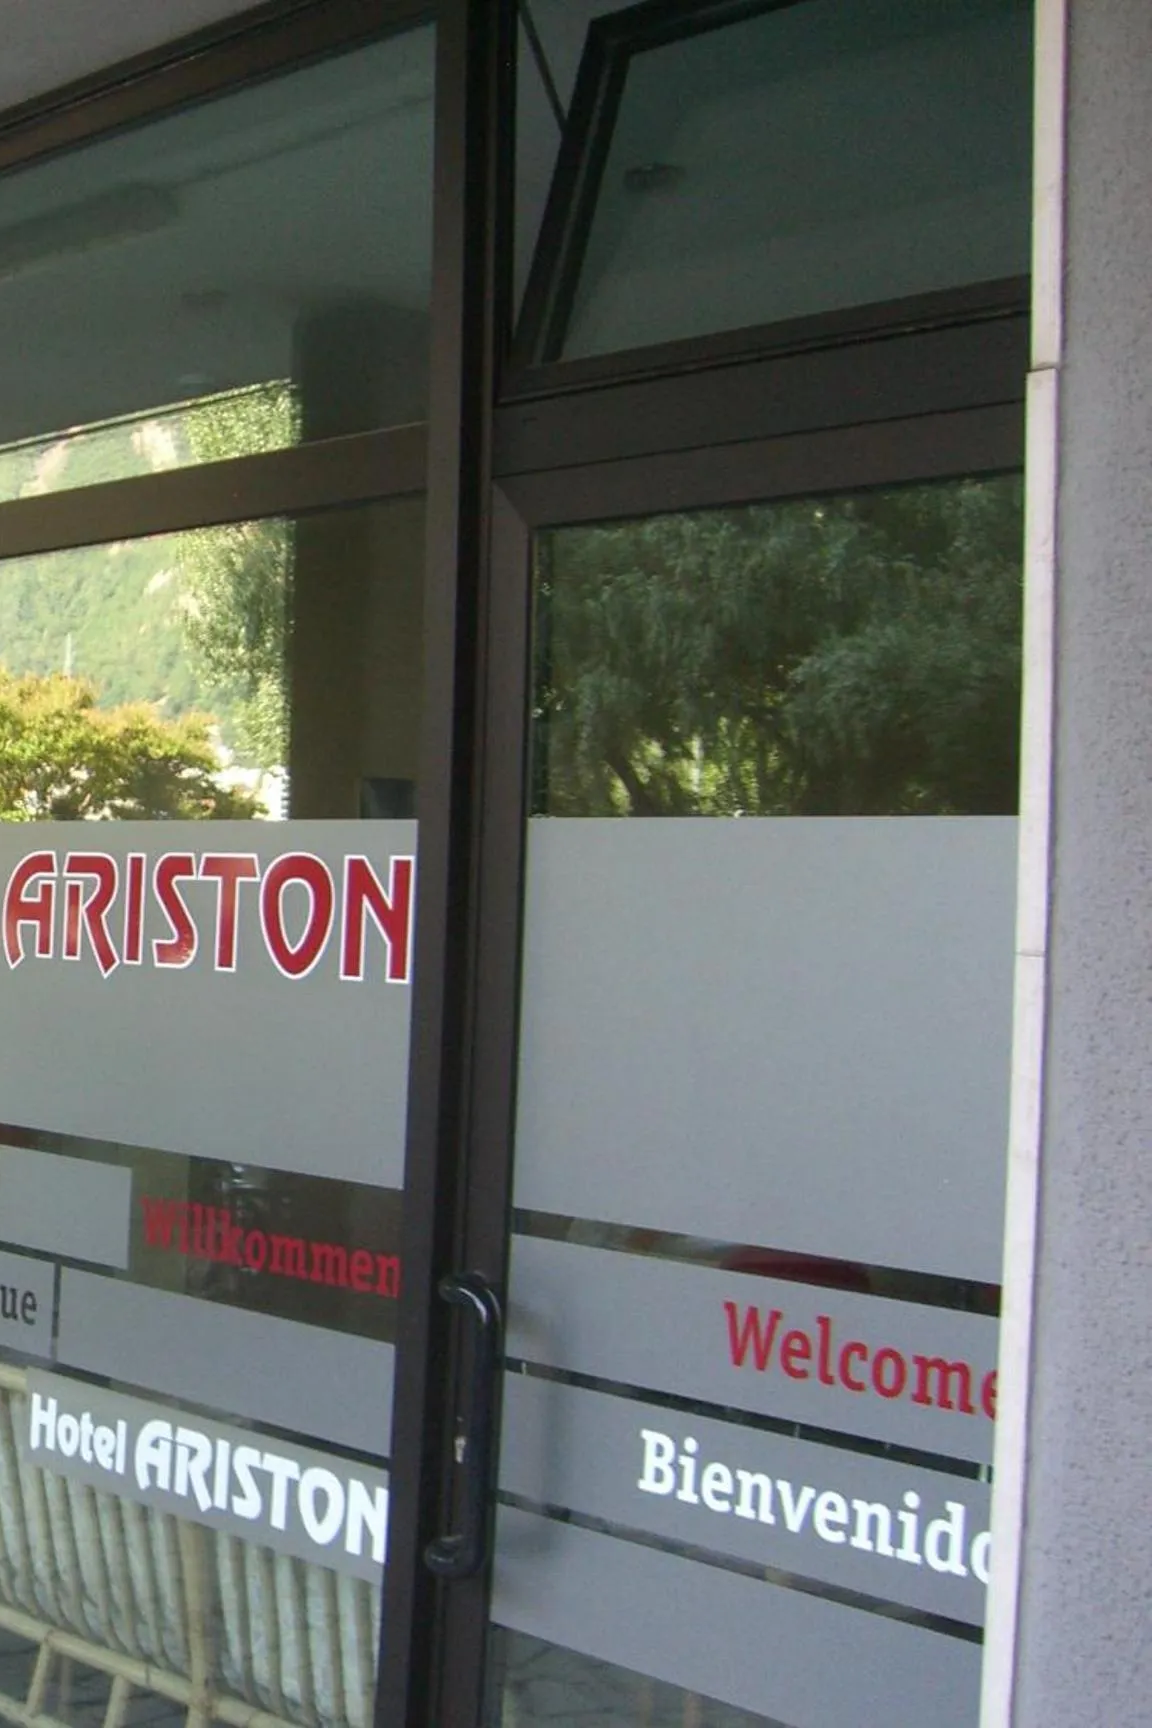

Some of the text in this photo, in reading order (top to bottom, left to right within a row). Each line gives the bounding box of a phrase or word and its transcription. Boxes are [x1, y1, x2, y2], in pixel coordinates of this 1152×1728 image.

[2, 850, 415, 984] ARISTON
[141, 1194, 402, 1299] Willkommen
[29, 1393, 388, 1564] Hotel ARISTON
